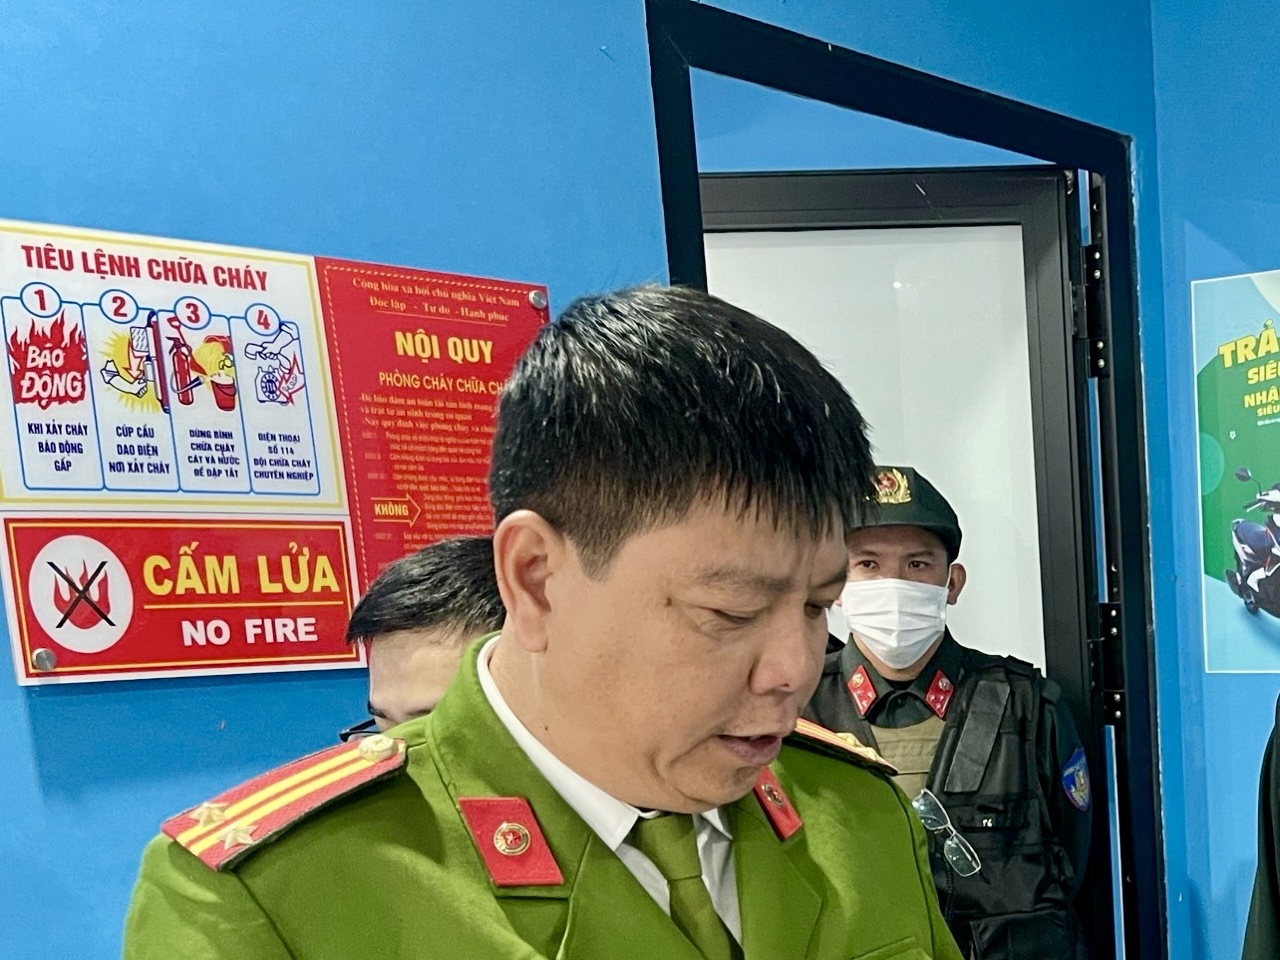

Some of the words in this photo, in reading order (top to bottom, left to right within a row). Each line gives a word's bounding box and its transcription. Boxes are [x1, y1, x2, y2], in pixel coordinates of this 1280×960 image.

[21, 244, 74, 271] TIÊU
[82, 249, 140, 279] LỆNH
[147, 257, 207, 285] CHỮA
[213, 266, 267, 291] CHÁY
[34, 290, 46, 311] 1
[112, 296, 128, 317] 2
[187, 303, 200, 323] 3
[257, 310, 271, 329] 4
[395, 328, 440, 363] NỘI
[447, 337, 493, 364] QUY
[1218, 319, 1280, 368] TRẢ
[27, 343, 65, 368] BÁO
[20, 370, 82, 406] ĐỘNG
[379, 369, 421, 388] PHÒNG
[423, 373, 454, 391] CHÁY
[456, 376, 487, 394] CHỮA
[1257, 403, 1280, 417] SIÊU
[28, 423, 43, 434] KHI
[45, 419, 62, 435] XẢY
[66, 422, 88, 435] CHÁY
[116, 424, 134, 438] CÚP
[38, 440, 56, 453] BÁO
[59, 440, 83, 456] ĐỘNG
[117, 444, 135, 456] DAO
[138, 443, 158, 458] ĐIỆN
[280, 446, 294, 455] 114
[54, 457, 72, 472] GẤP
[109, 461, 125, 473] NƠI
[128, 458, 144, 473] XẢY
[147, 461, 170, 474] CHÁY
[374, 502, 409, 516] KHÔNG
[143, 541, 240, 596] CẤM
[256, 542, 340, 594] LỬA
[181, 619, 231, 647] NO
[245, 617, 319, 644] FIRE
